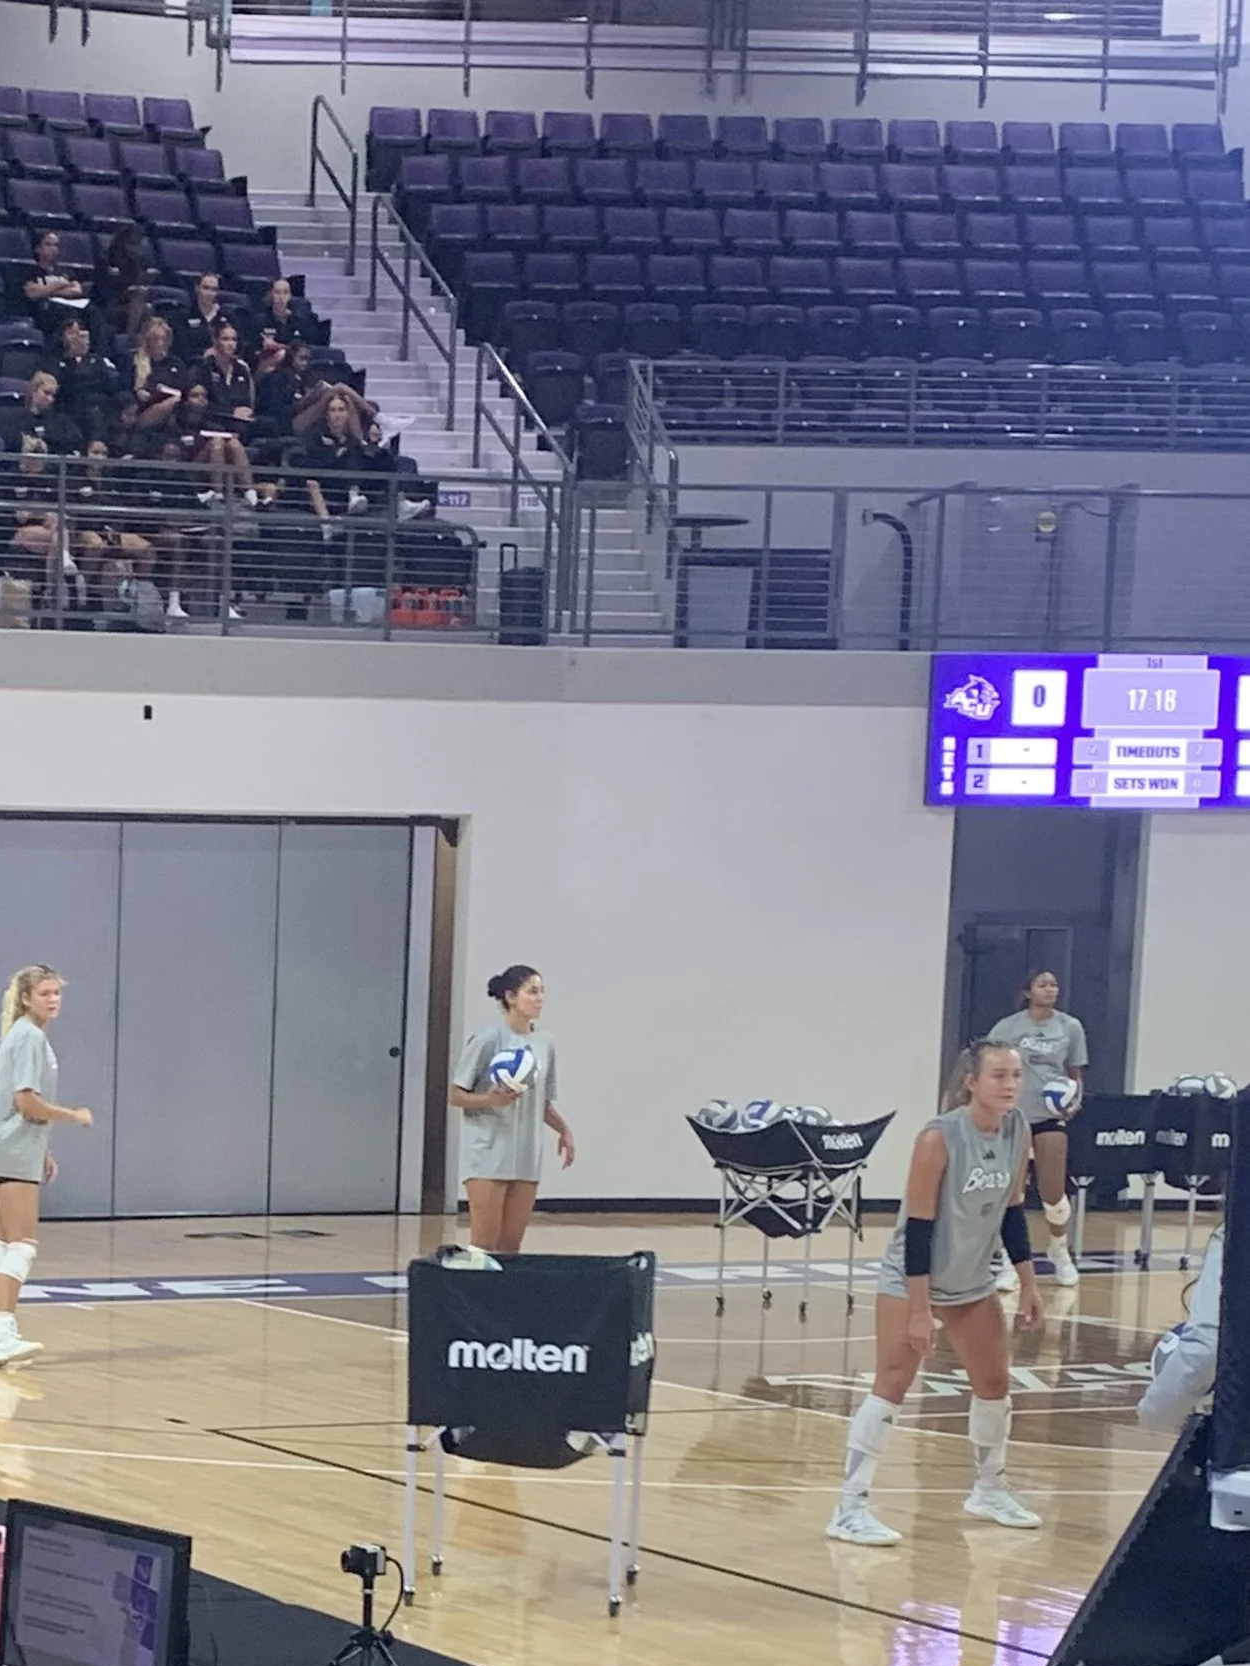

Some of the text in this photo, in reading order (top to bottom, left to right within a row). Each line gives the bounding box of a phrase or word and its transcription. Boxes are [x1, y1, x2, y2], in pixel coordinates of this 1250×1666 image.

[1033, 685, 1046, 707] 0
[1116, 745, 1180, 758] TIMEOUTS
[973, 774, 985, 789] 2
[1114, 777, 1179, 790] SETS WON
[448, 1338, 587, 1373] molten
